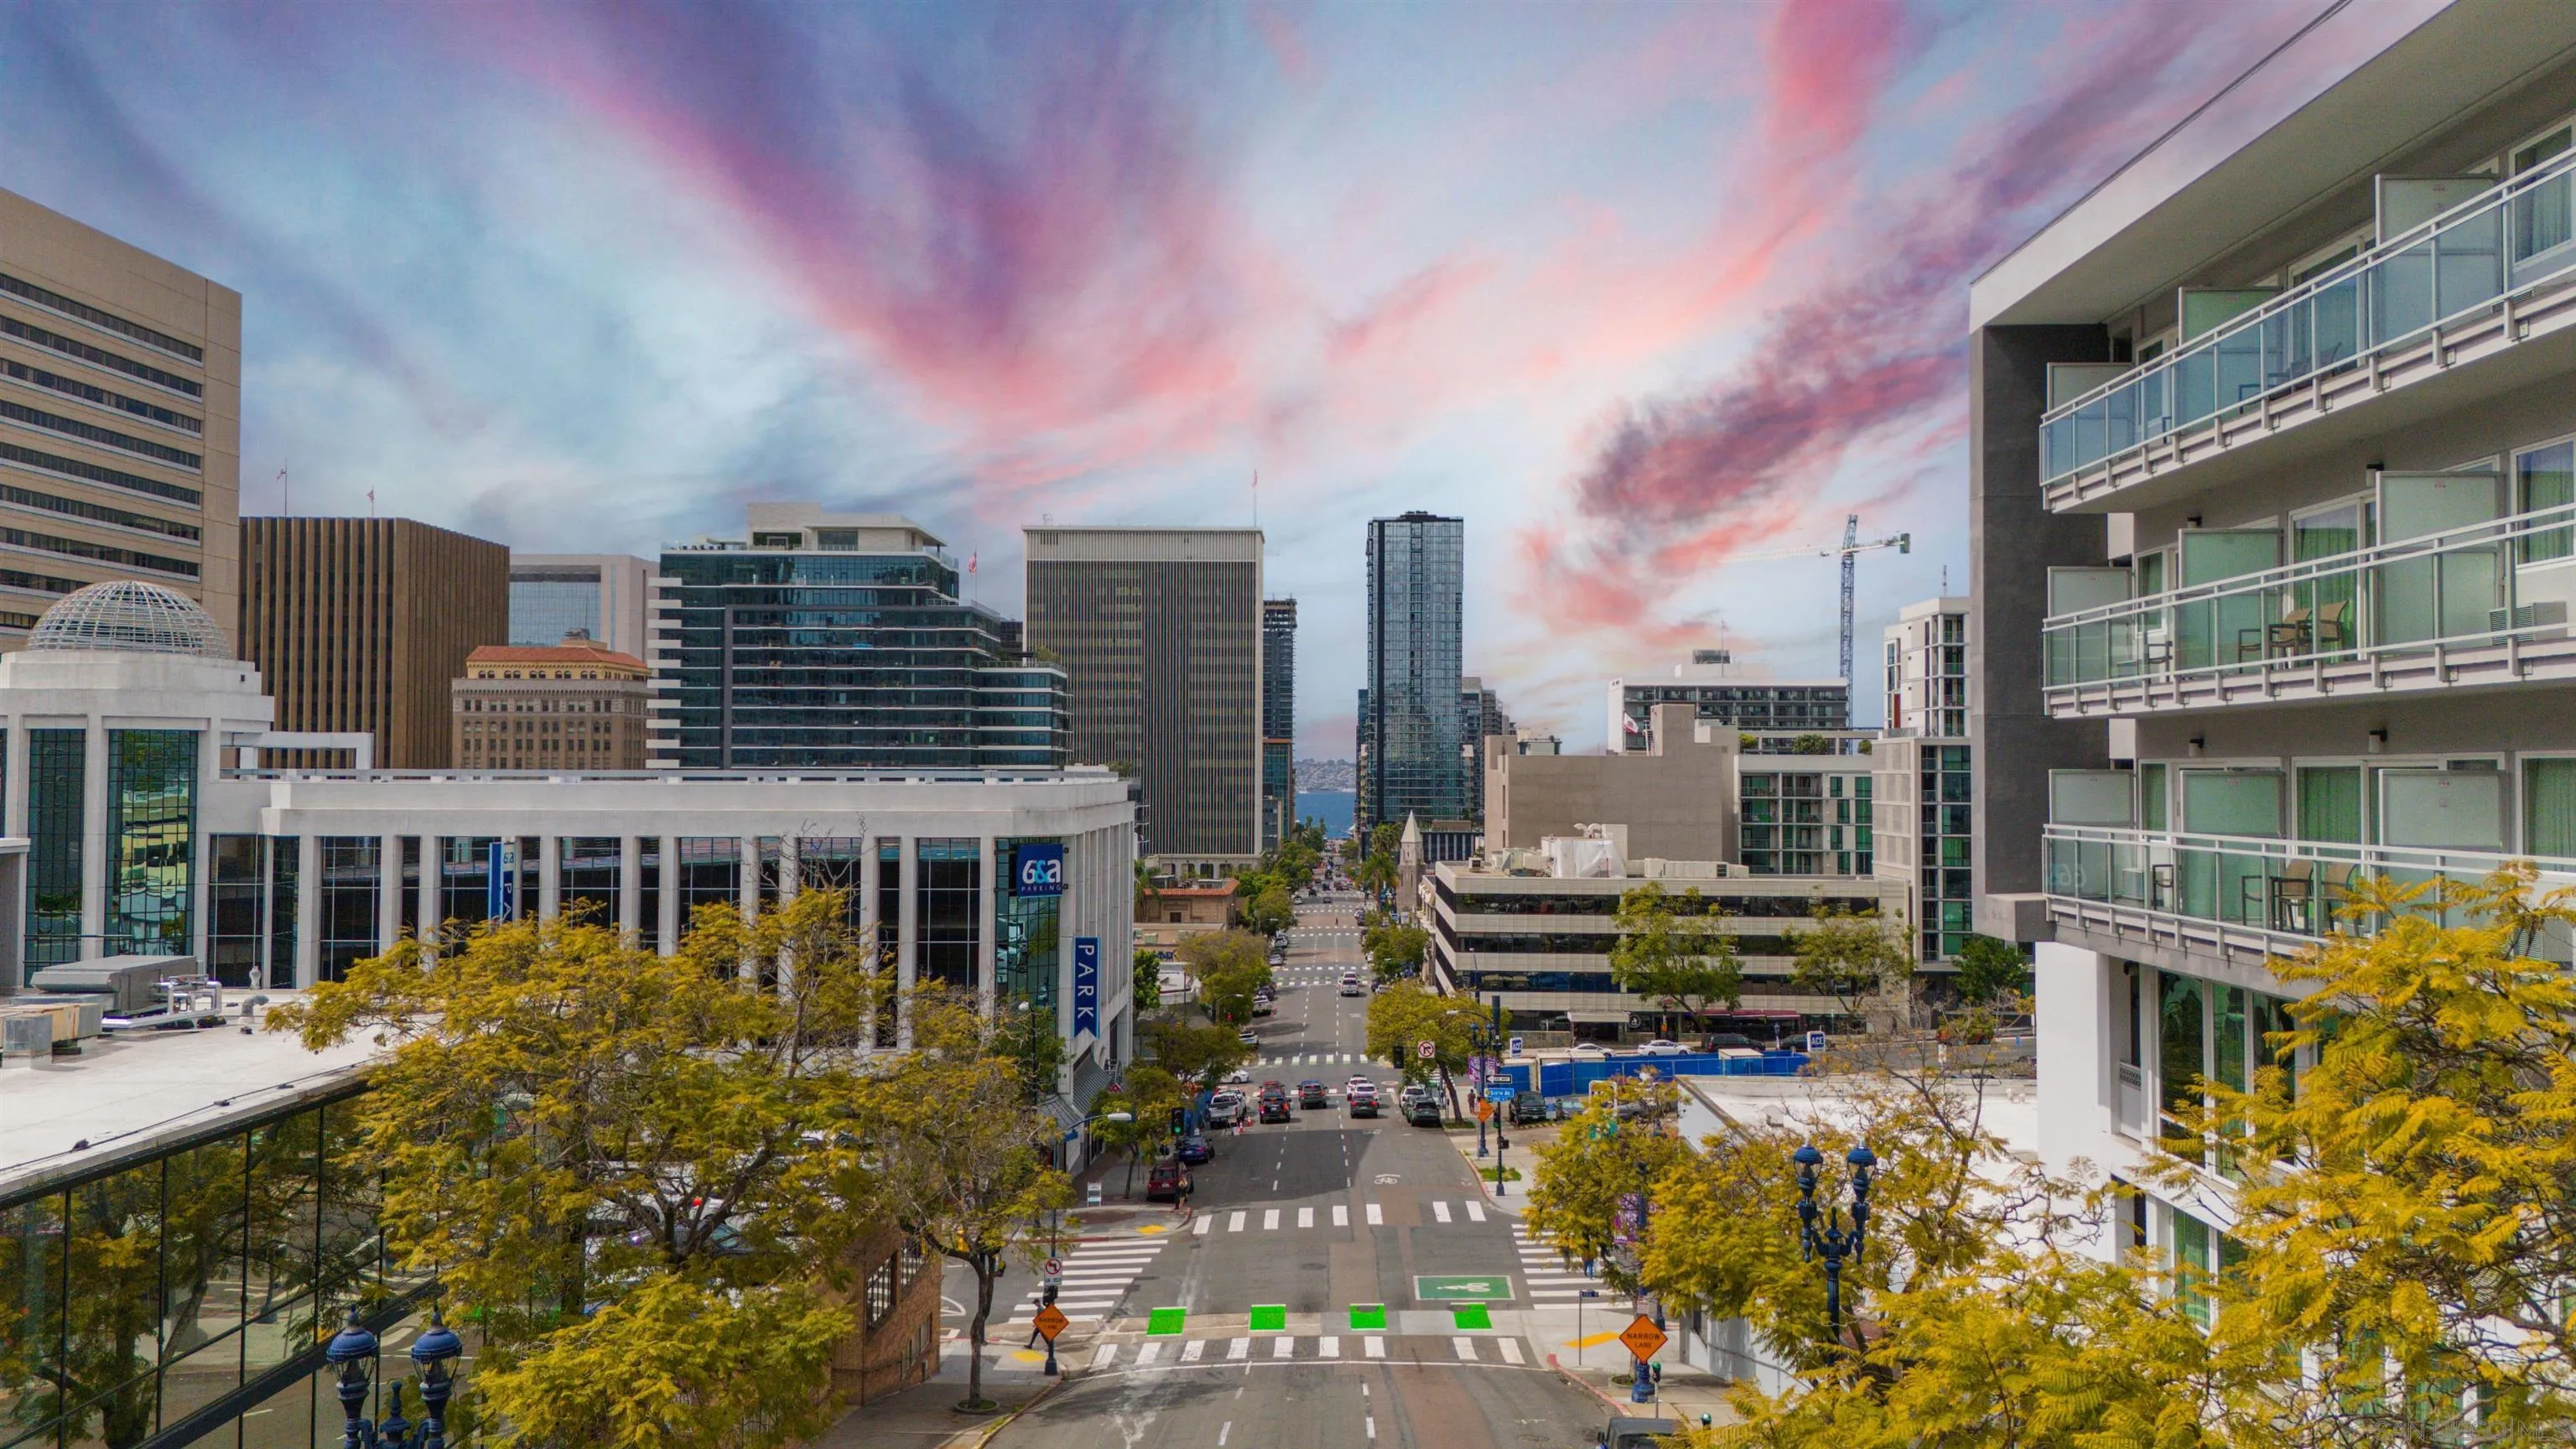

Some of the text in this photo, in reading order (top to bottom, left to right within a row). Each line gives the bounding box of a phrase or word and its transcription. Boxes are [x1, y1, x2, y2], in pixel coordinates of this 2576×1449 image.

[1022, 860, 1061, 884] 6&a
[1078, 945, 1094, 1019] PARK
[1811, 1036, 1823, 1045] ACE
[1627, 1332, 1660, 1340] NARROW
